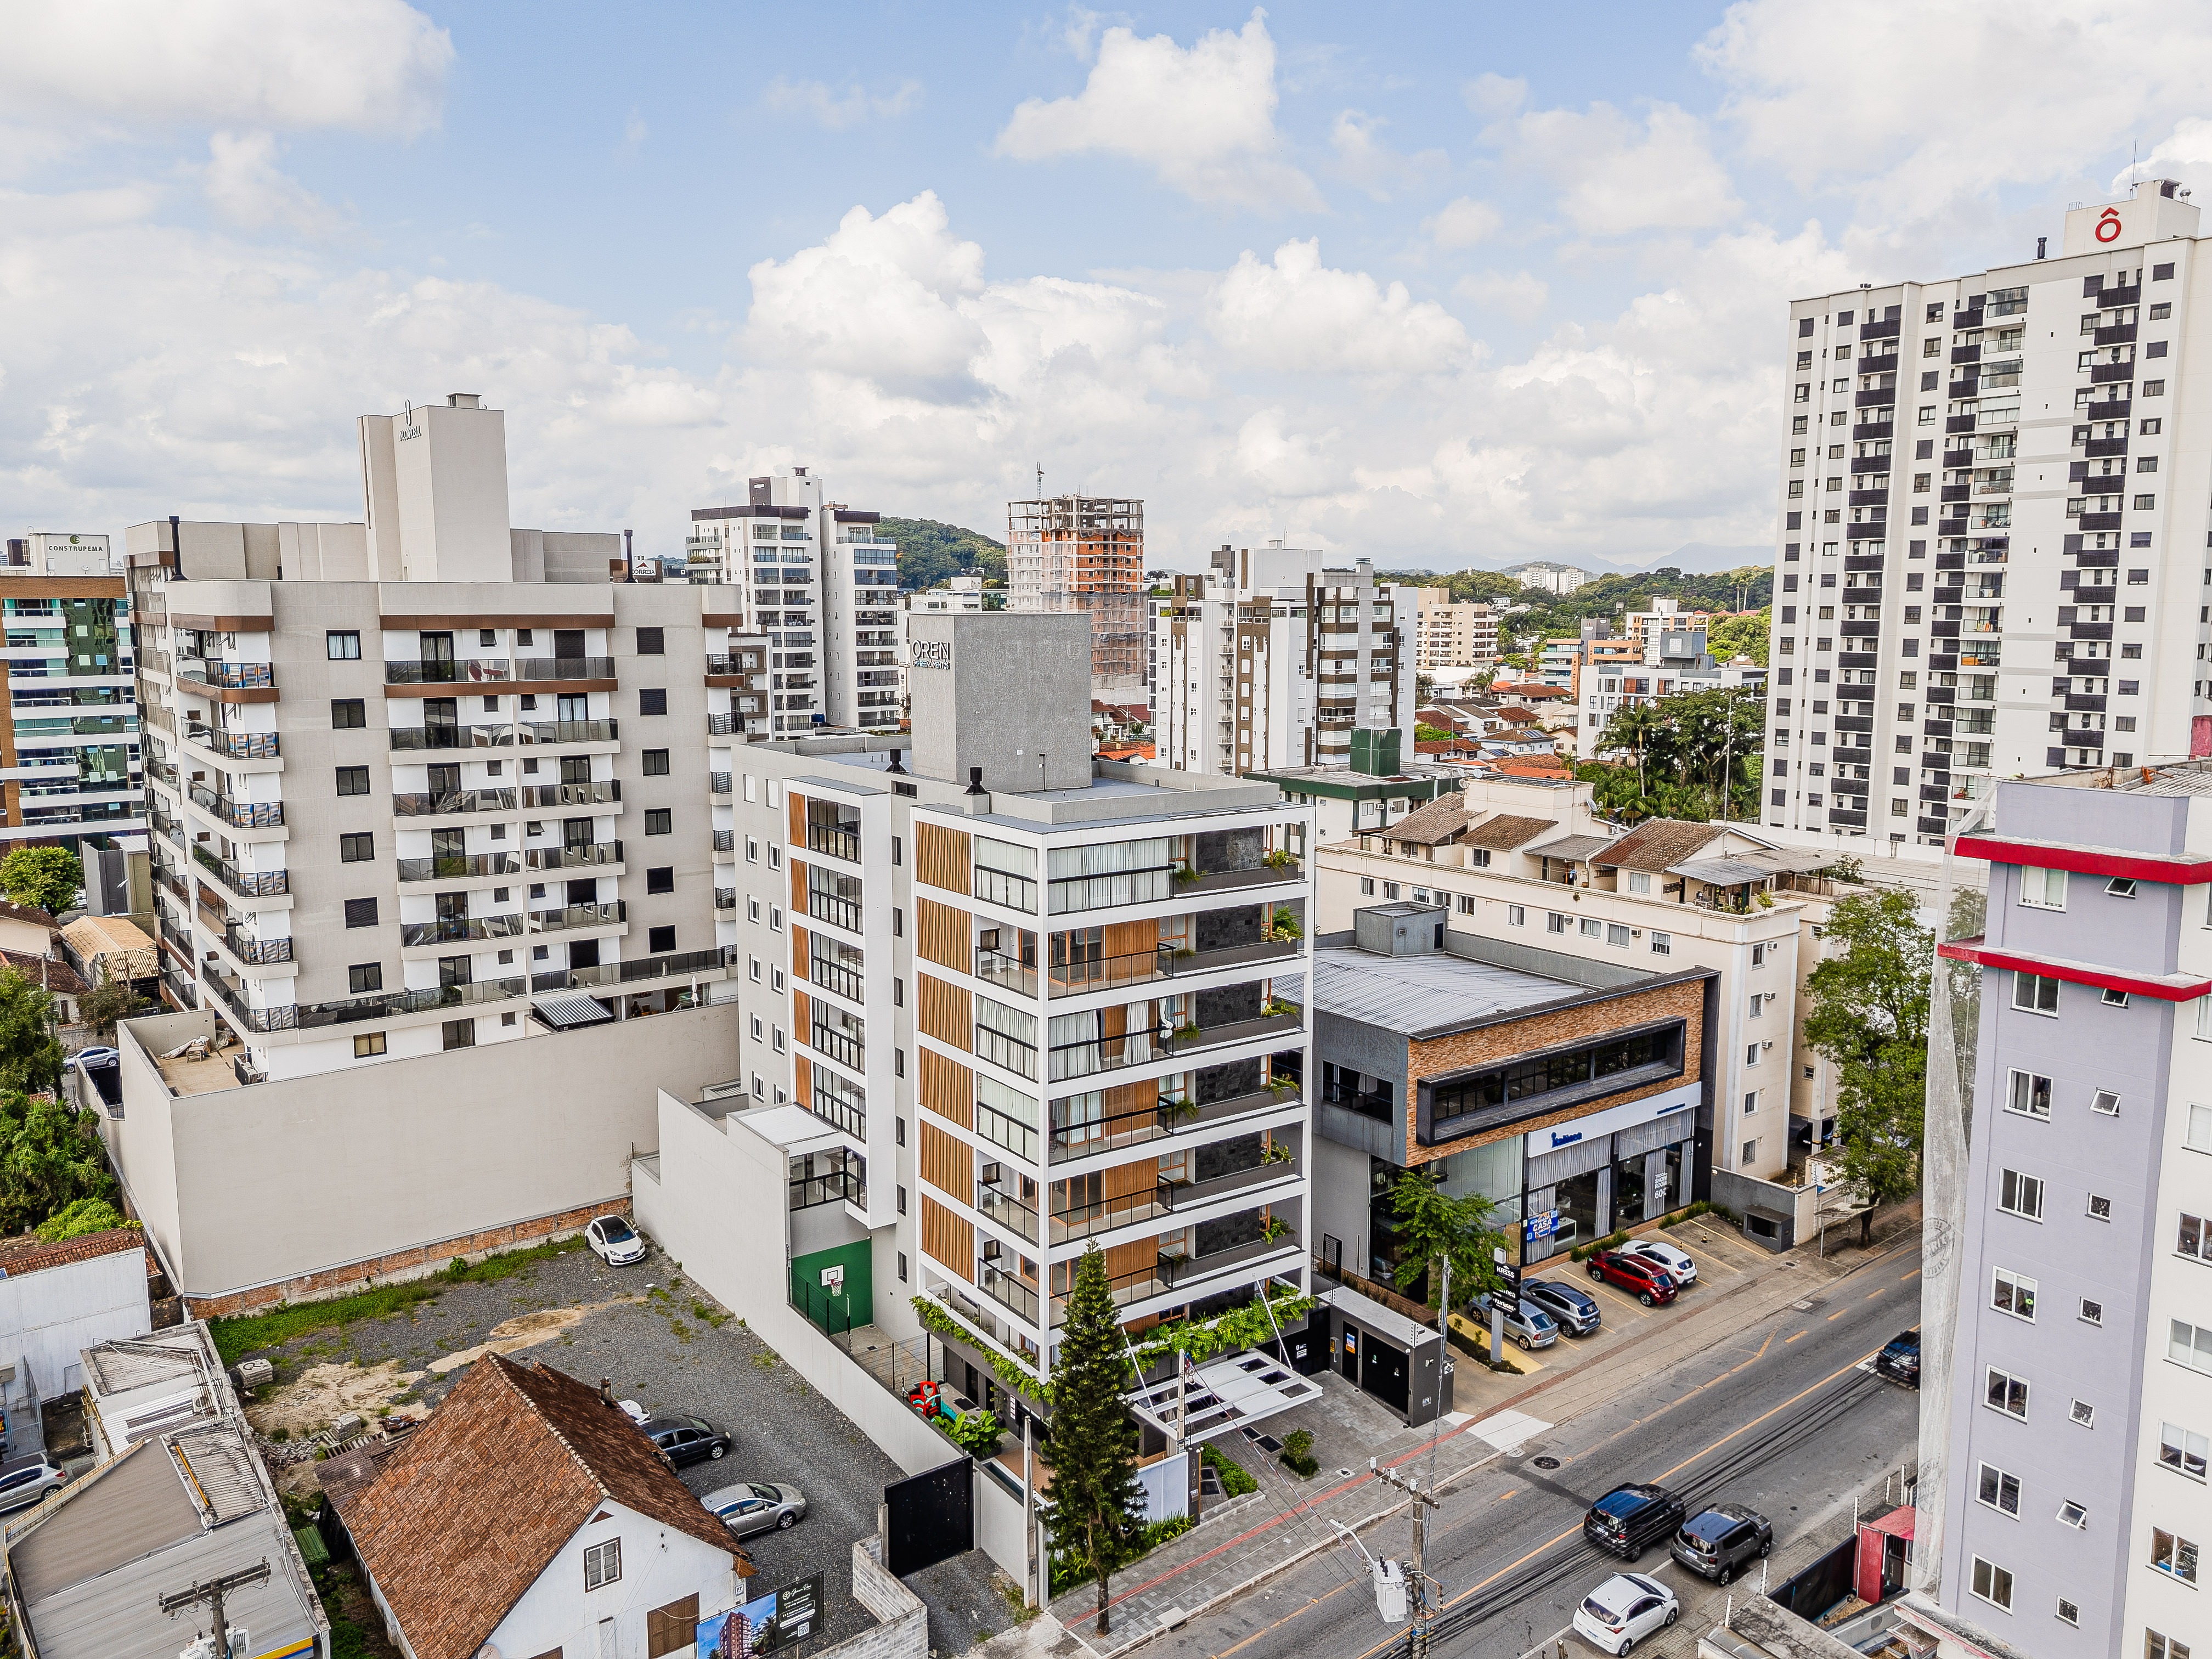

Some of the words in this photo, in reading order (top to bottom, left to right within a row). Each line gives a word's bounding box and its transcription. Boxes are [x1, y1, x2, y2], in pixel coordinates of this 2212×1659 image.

[2095, 207, 2121, 242] Ô
[911, 640, 950, 660] OREN
[1533, 1218, 1552, 1232] CASA
[1497, 1265, 1514, 1278] KRESS
